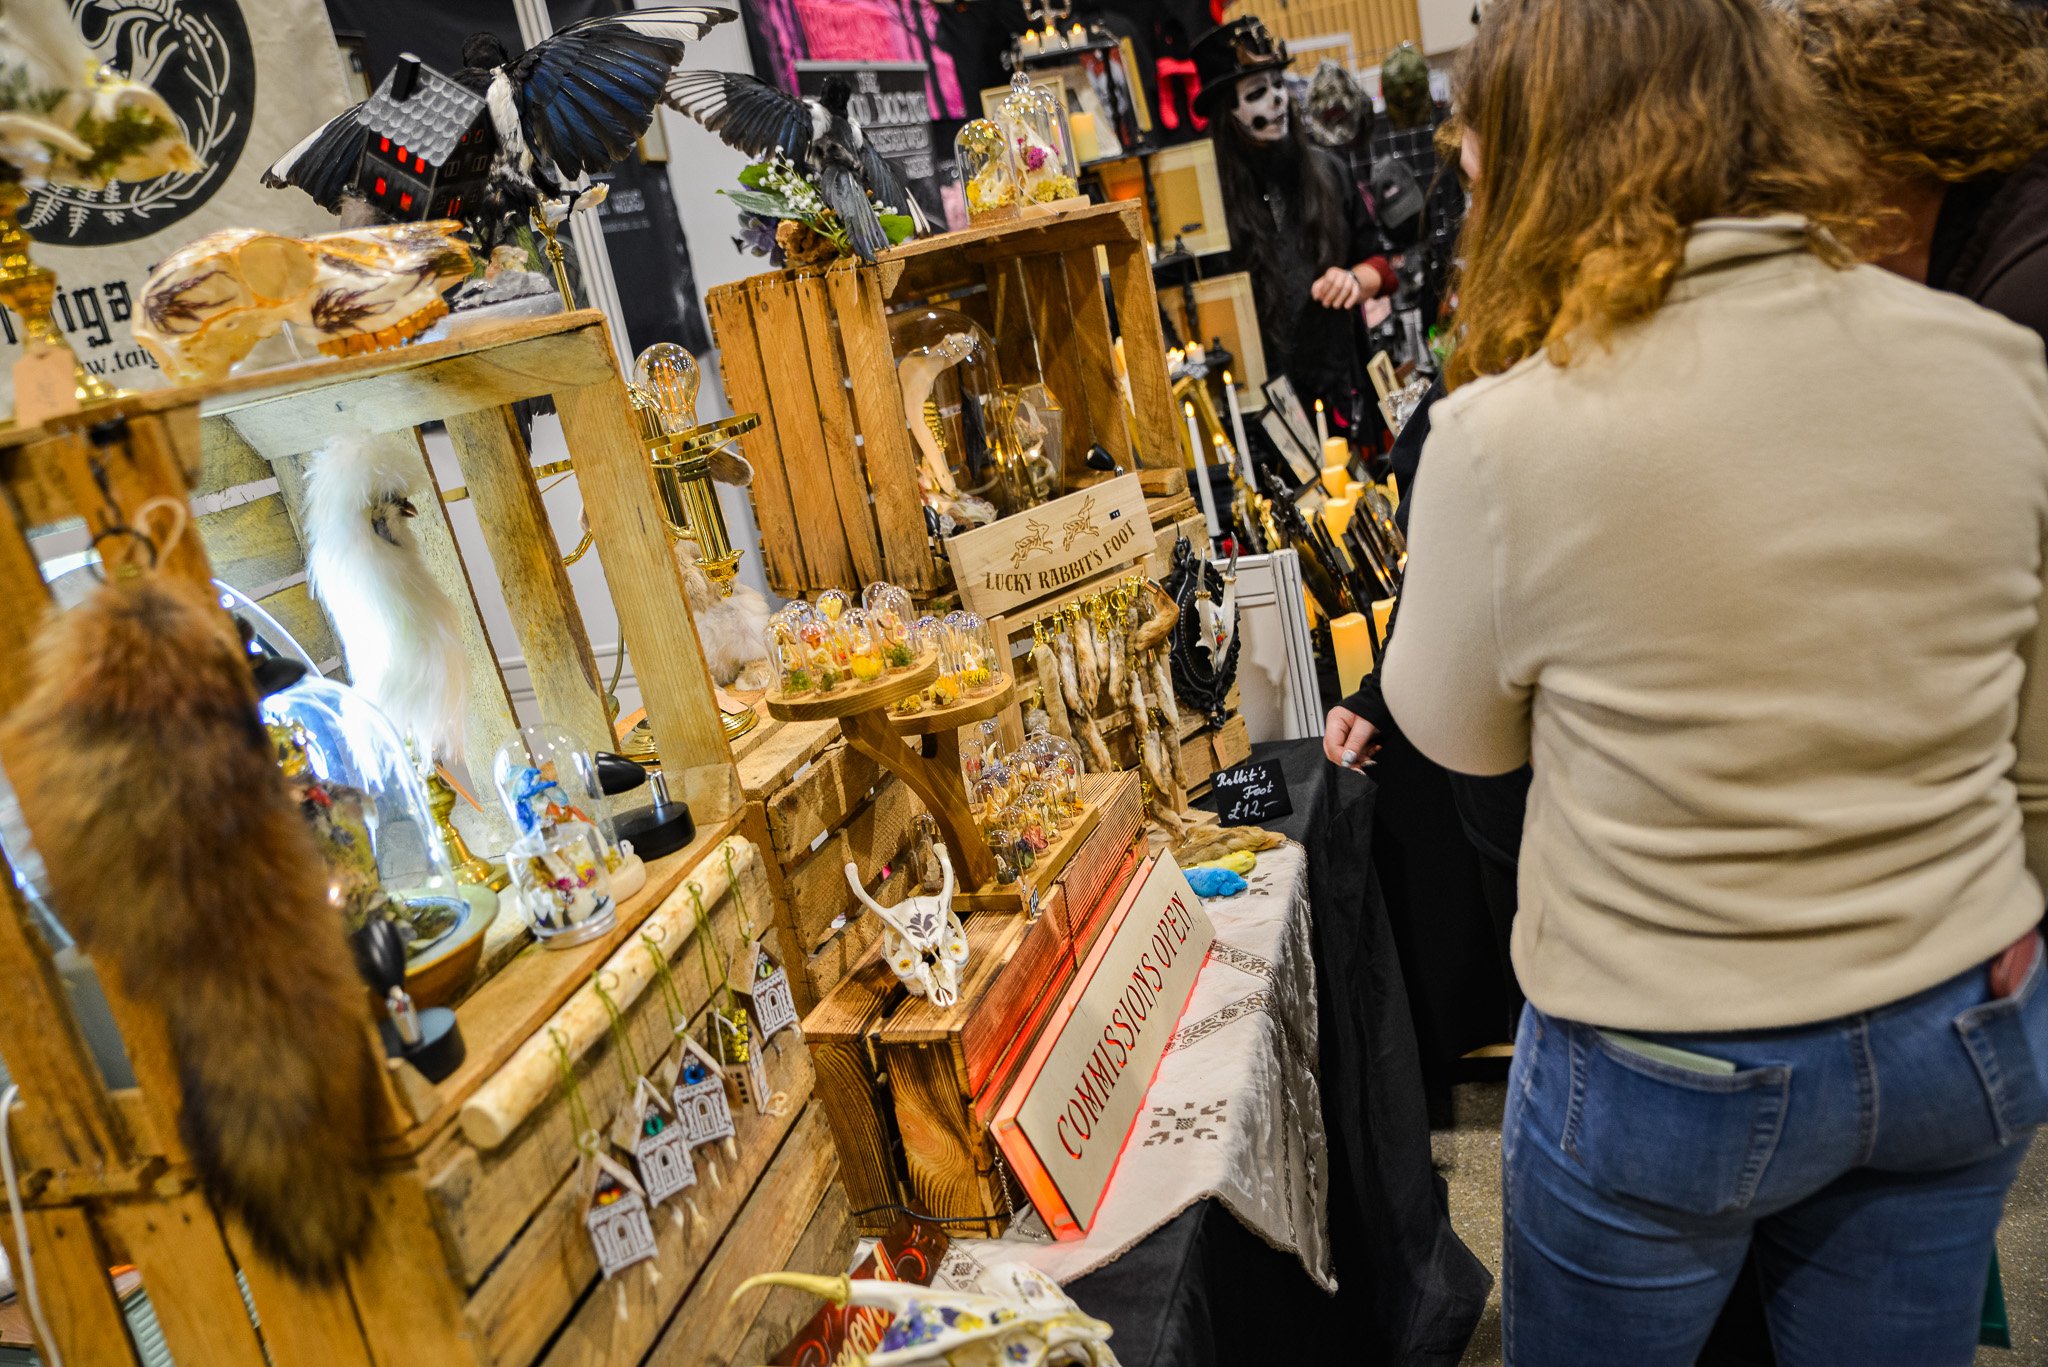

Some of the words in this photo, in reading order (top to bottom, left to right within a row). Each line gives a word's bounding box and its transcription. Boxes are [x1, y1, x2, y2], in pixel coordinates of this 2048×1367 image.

[986, 572, 1032, 595] LUCKY
[1038, 550, 1103, 589] RABBIT'S
[1103, 520, 1136, 559] FOOT
[1216, 766, 1266, 787] Rabbit's
[1242, 780, 1274, 799] Foot
[1057, 953, 1163, 1160] COMMISSIONS
[1151, 891, 1195, 969] OPEN
